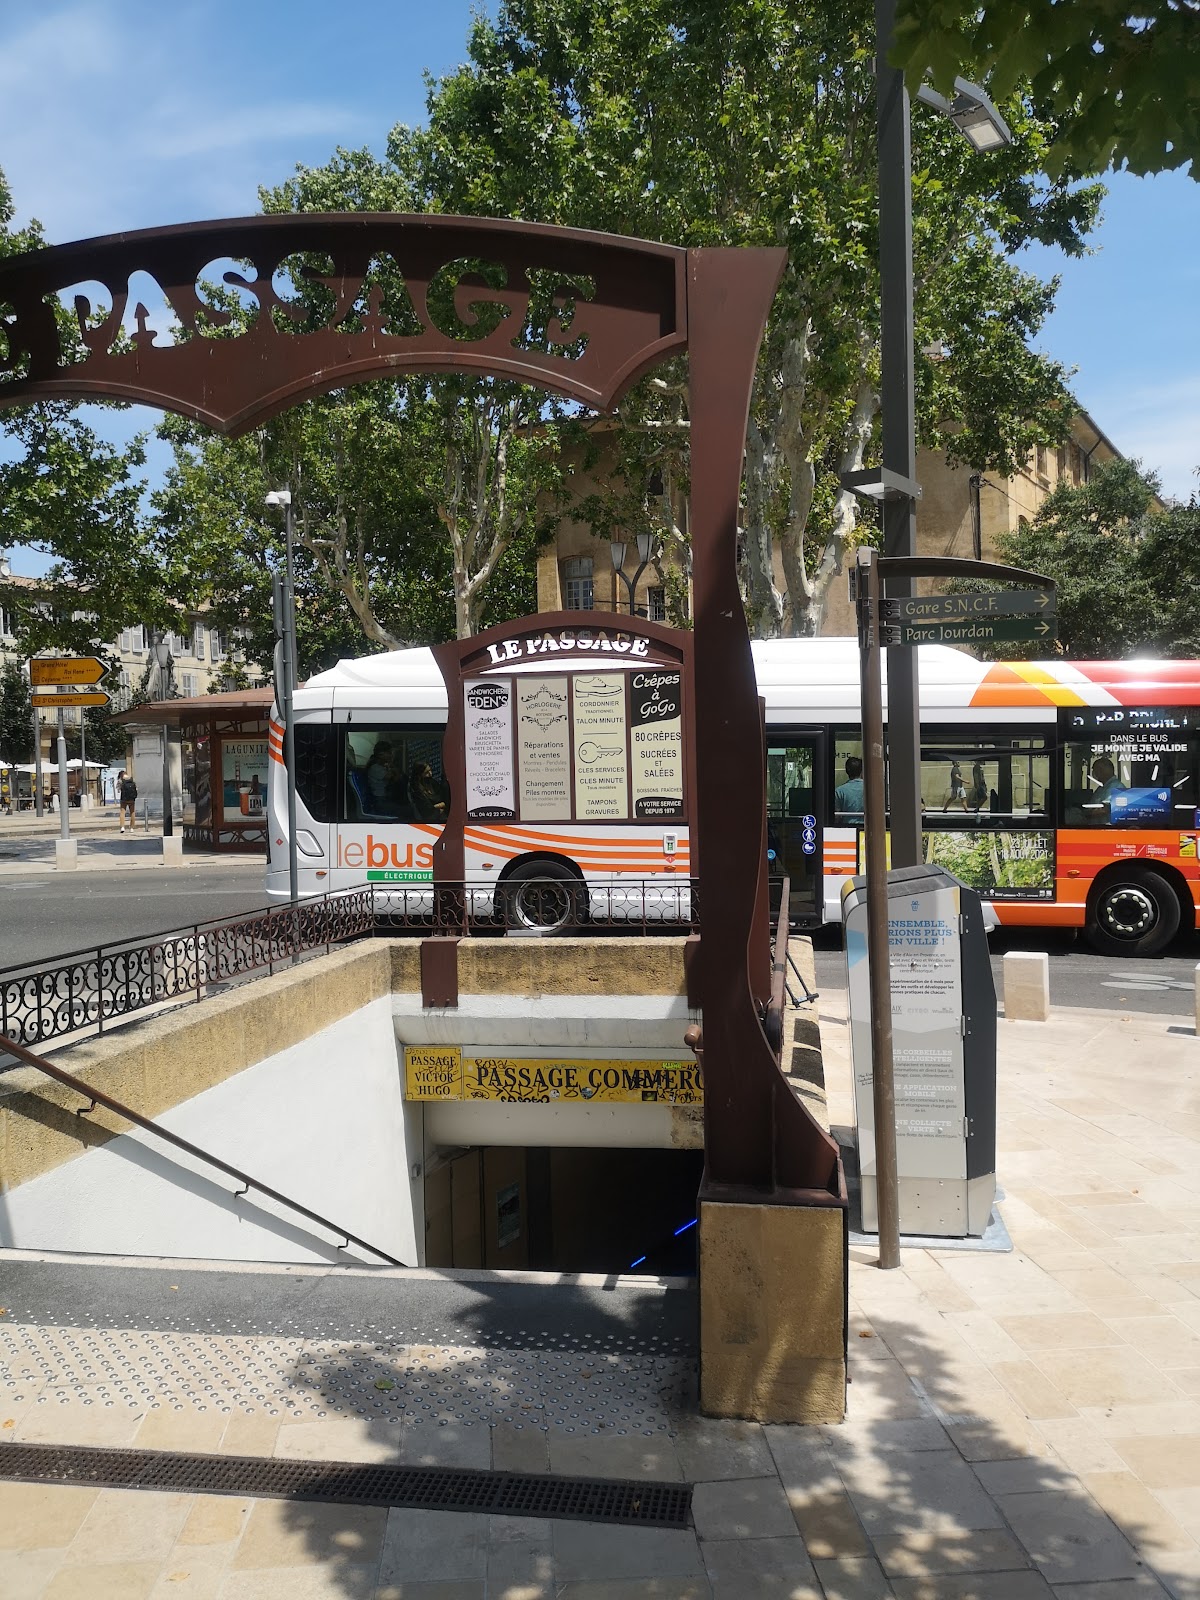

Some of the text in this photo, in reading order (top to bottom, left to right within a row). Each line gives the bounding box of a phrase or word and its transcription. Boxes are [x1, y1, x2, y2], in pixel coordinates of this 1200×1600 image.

[42, 250, 596, 367] PASSAGE
[905, 598, 998, 615] Gare S.N.C.F.
[906, 625, 994, 641] Parc Jourdan
[487, 631, 650, 664] LE PASSAGE
[633, 673, 680, 689] Crêpes
[652, 689, 660, 700] à
[469, 696, 509, 708] EDEN'S
[526, 701, 562, 711] HORLOGERIE
[640, 699, 676, 719] GoGo
[635, 731, 682, 742] 80 CRÊPES
[1150, 734, 1168, 742] BUS
[226, 745, 269, 754] LAGUNITA
[524, 742, 564, 750] Réparations
[1139, 744, 1152, 752] JE
[1153, 744, 1187, 752] VALIDE
[640, 748, 677, 758] SUCRÉES
[1118, 754, 1160, 762] AVEC MA
[644, 768, 674, 777] SALÉES
[250, 799, 262, 808] IPA
[1031, 850, 1048, 860] 2021
[888, 920, 948, 928] NSEMBLE,
[411, 1056, 456, 1066] PASSAGE
[415, 1072, 454, 1082] VICTOR
[477, 1067, 704, 1090] PASSAGE COMMERC
[419, 1086, 450, 1095] HUGO
